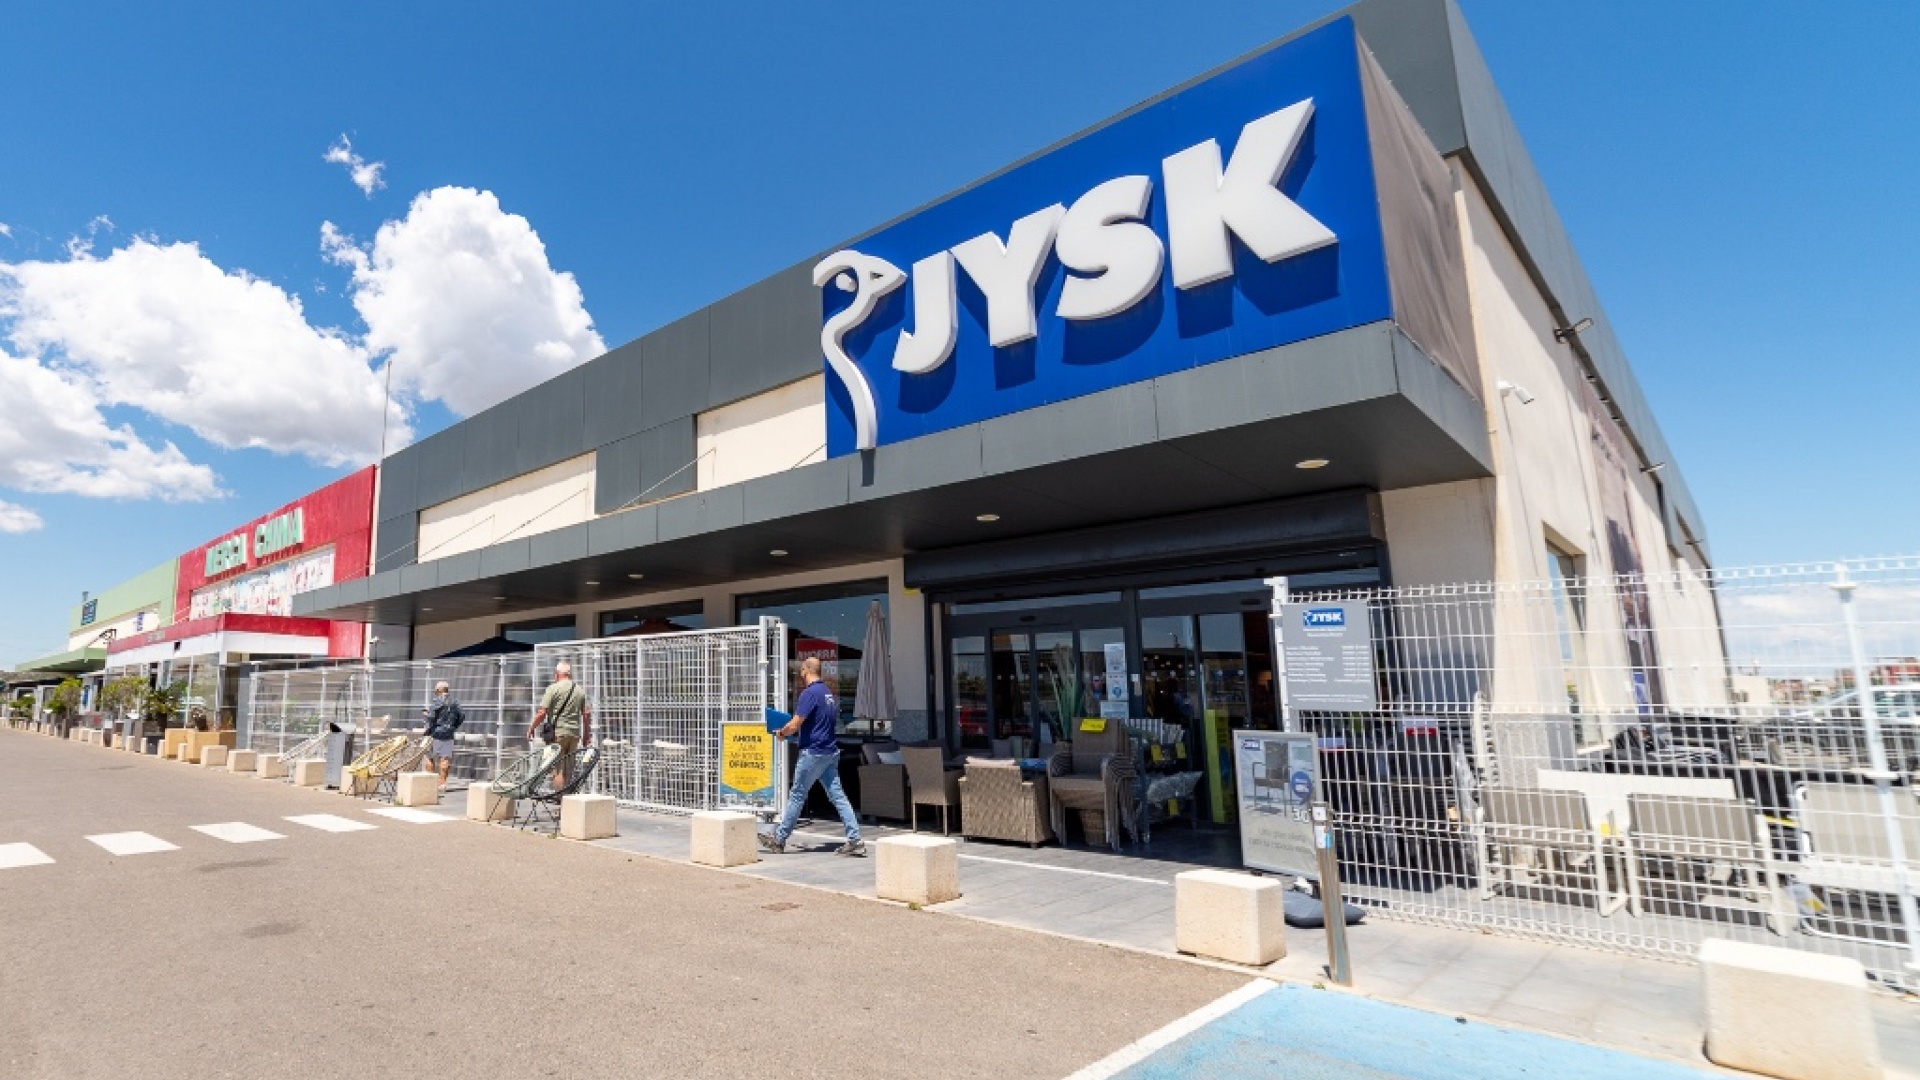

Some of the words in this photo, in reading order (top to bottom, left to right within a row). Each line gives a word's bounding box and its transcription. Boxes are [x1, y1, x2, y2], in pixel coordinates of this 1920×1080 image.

[892, 97, 1338, 374] JYSK
[1311, 612, 1342, 622] JYSK
[729, 760, 766, 770] OFERTAS
